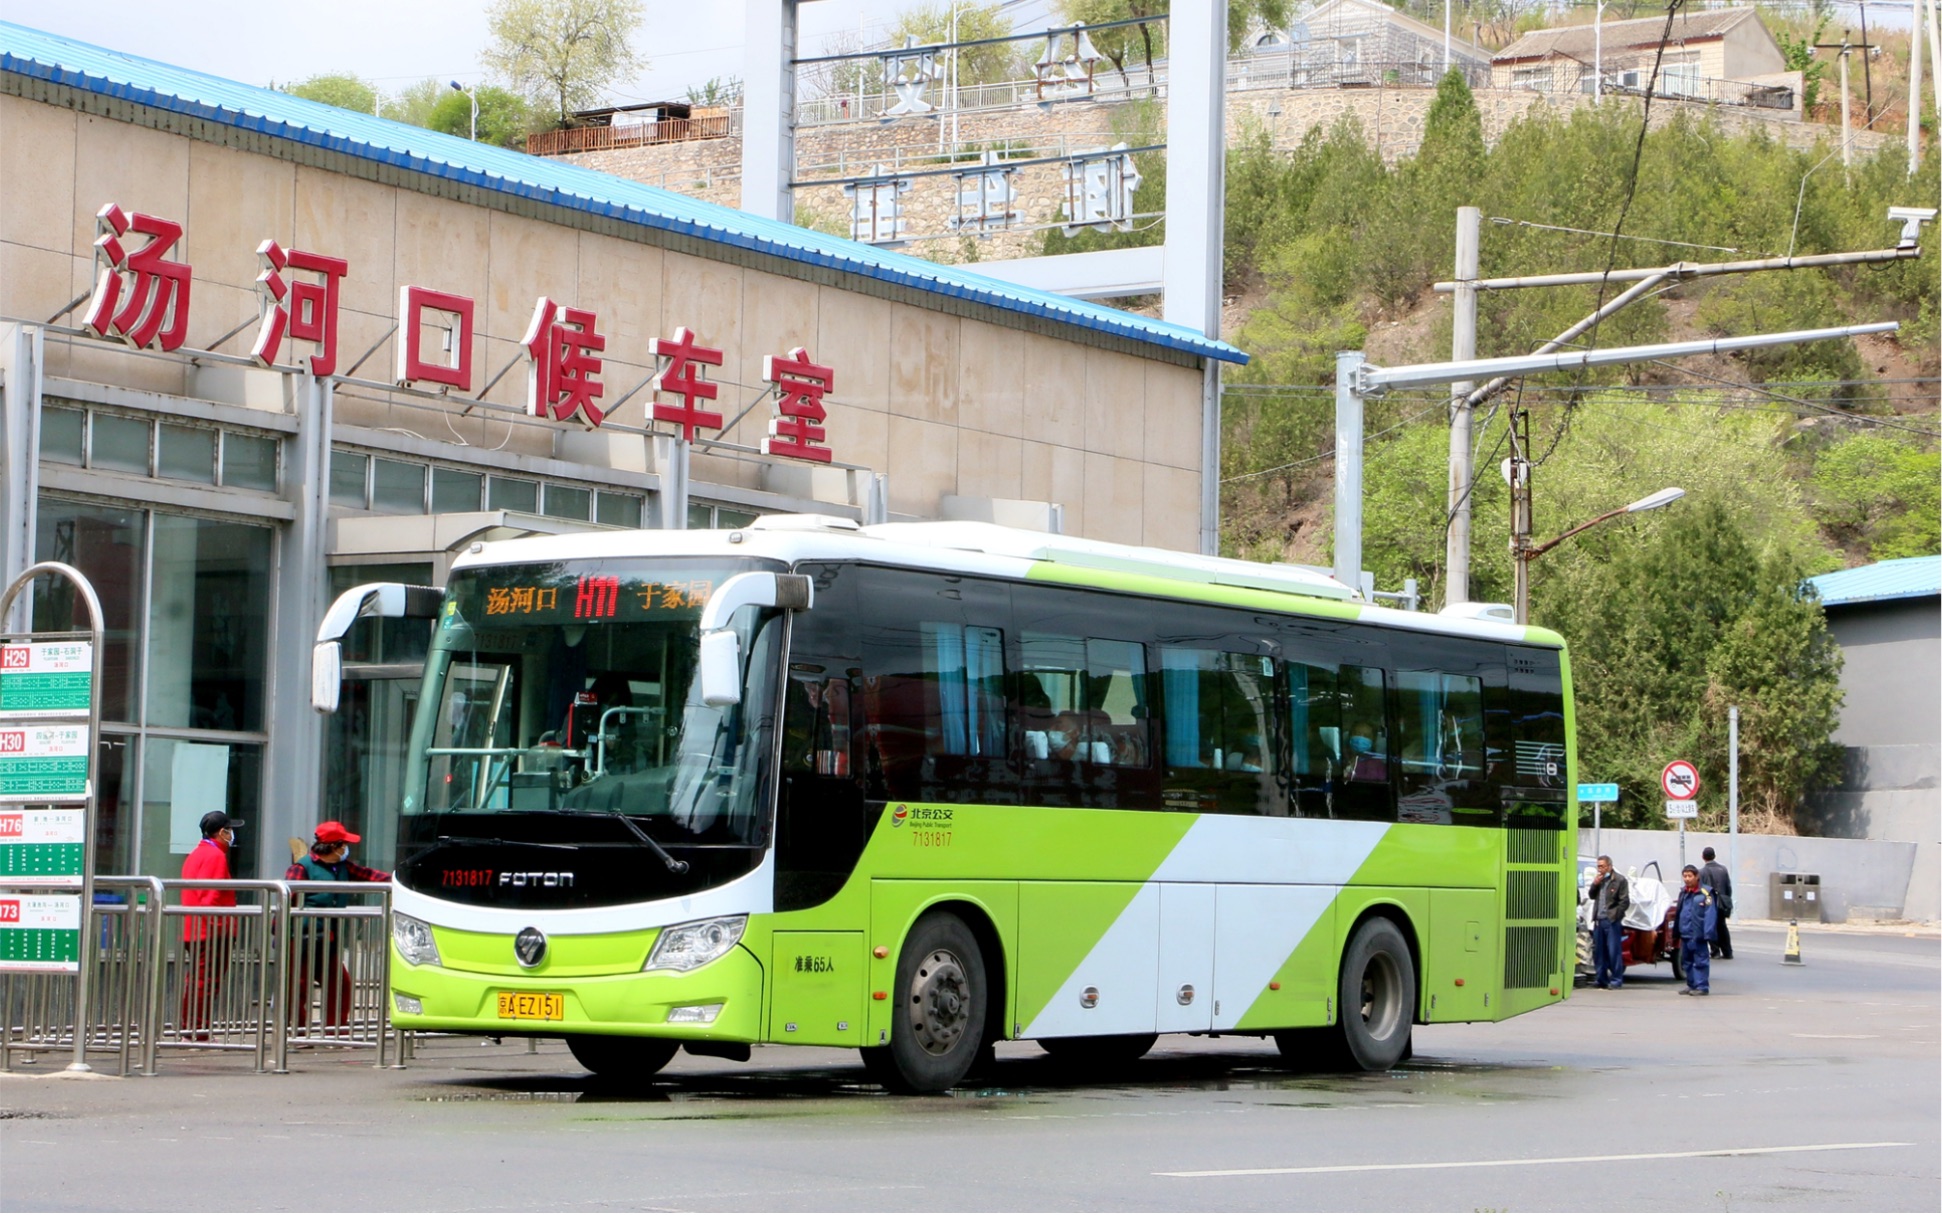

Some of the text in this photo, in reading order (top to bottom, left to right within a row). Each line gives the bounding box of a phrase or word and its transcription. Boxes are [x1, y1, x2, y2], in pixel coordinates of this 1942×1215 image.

[83, 203, 834, 463] 汤河口候车室
[486, 587, 557, 615] 汤河口
[637, 580, 712, 610] 于家园
[4, 650, 27, 666] H29
[0, 733, 22, 750] H30
[911, 808, 953, 820] 北京公交
[0, 819, 21, 832] H76
[913, 831, 952, 847] 7131817
[442, 870, 574, 887] 7131817 FOTON
[794, 955, 834, 973] 准乘65人
